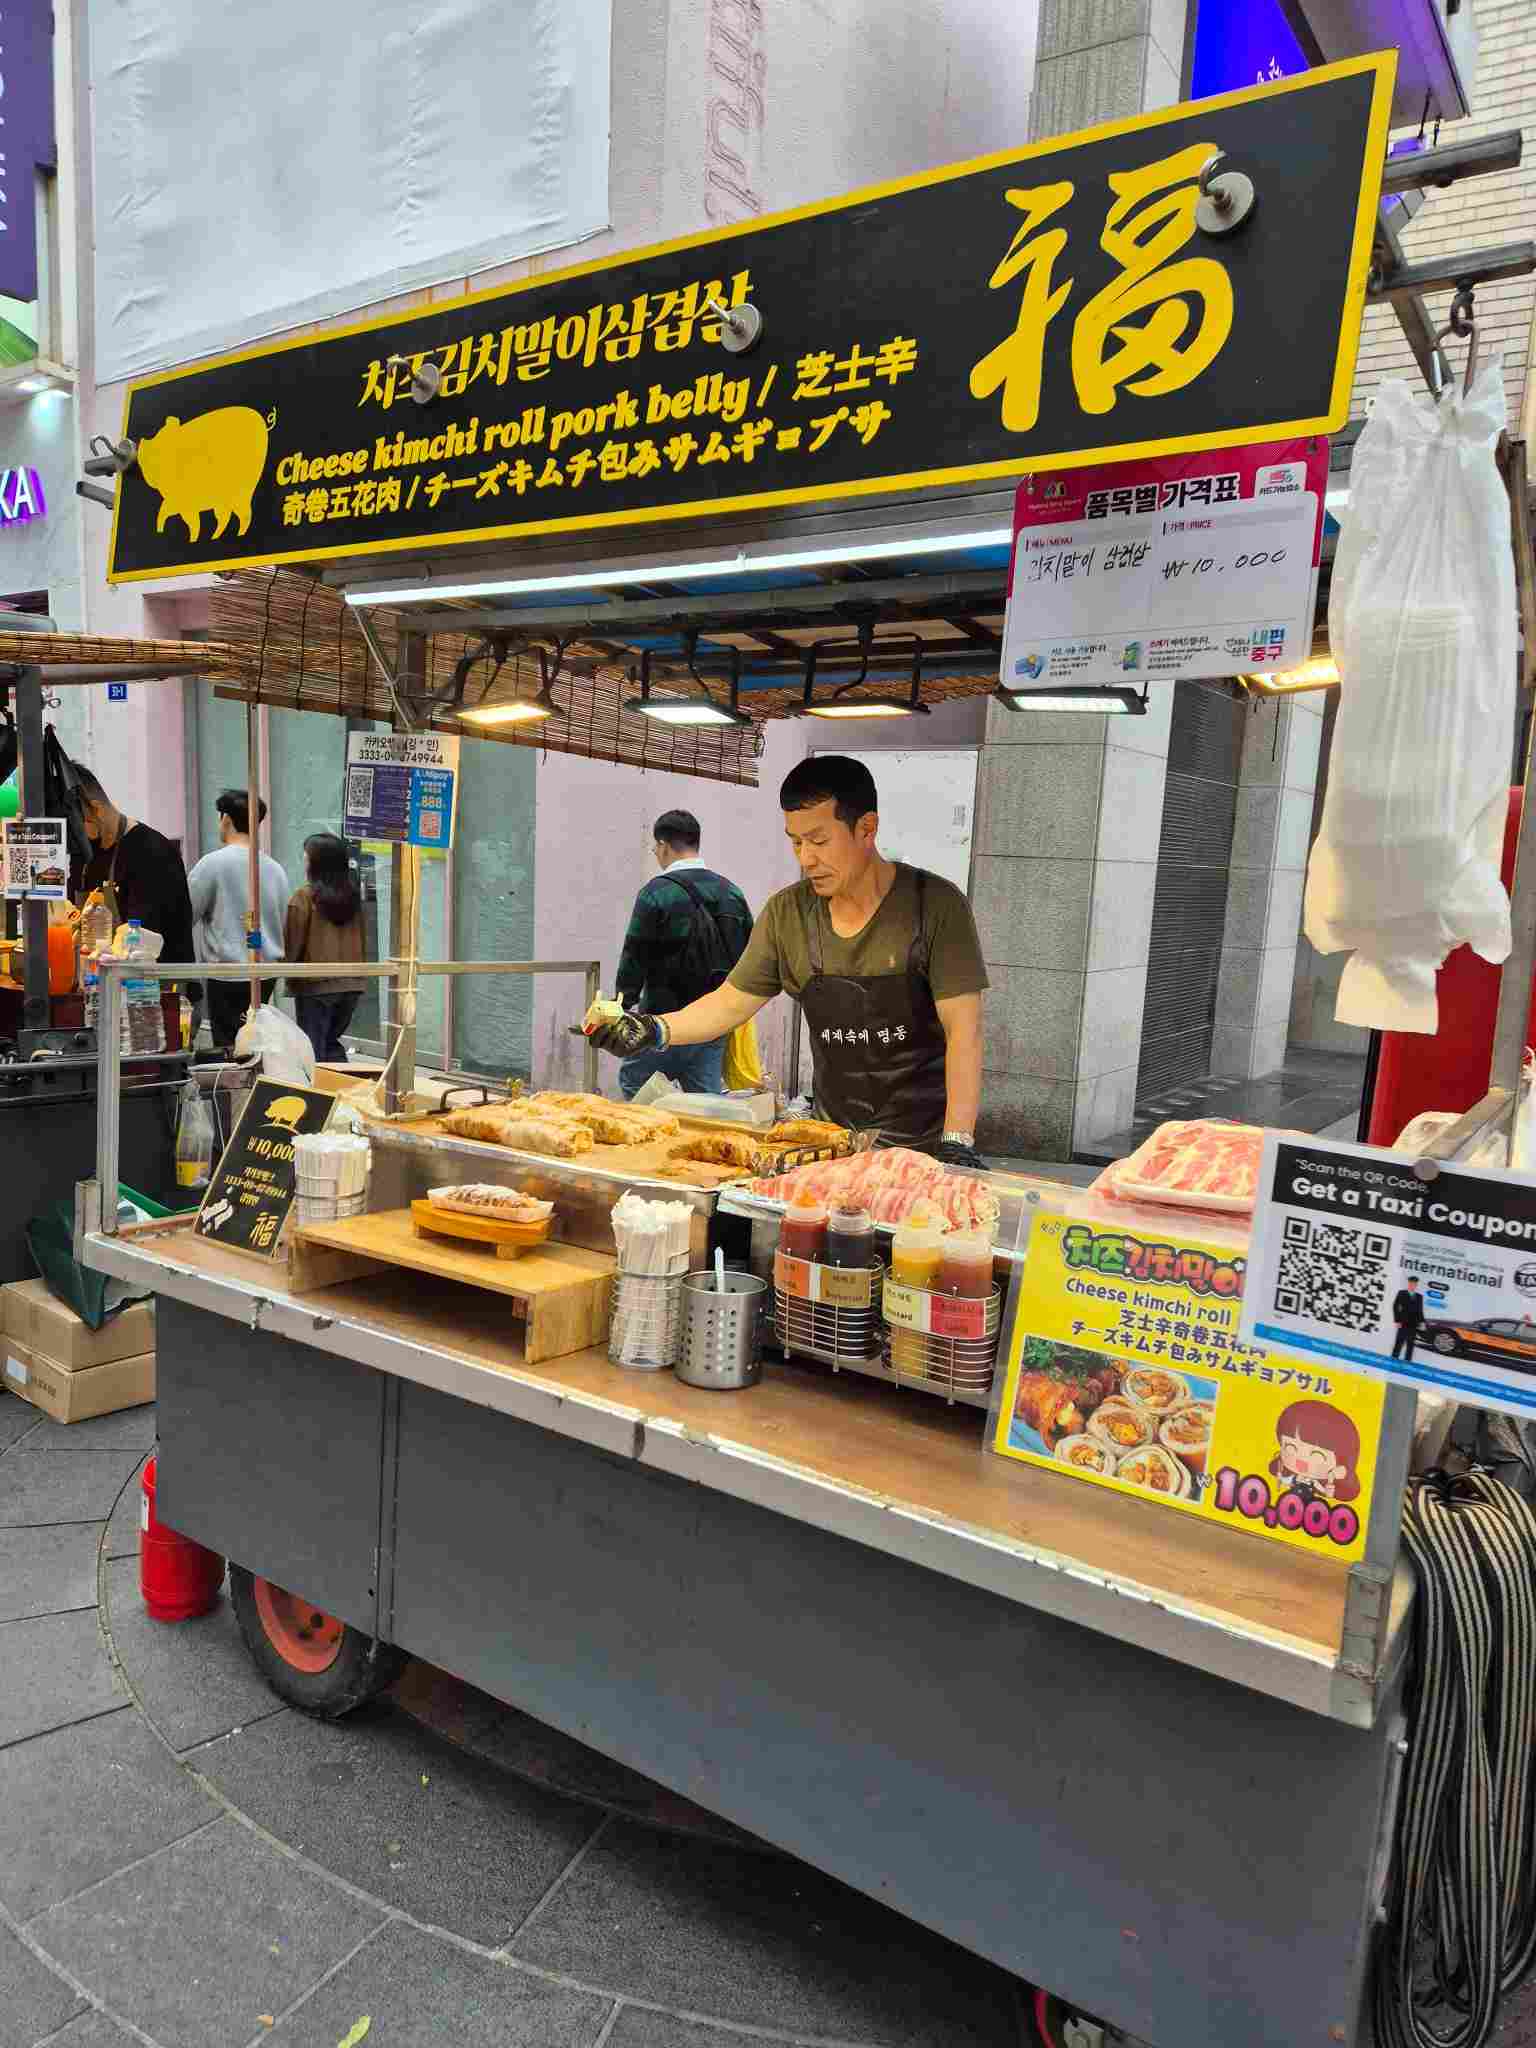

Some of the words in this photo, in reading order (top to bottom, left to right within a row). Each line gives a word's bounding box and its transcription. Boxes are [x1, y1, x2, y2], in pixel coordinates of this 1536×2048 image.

[970, 142, 1234, 433] 福
[357, 269, 753, 410] 치즈김치말이삼겹살
[275, 448, 368, 487] Cheese
[373, 416, 479, 471] kimchi
[483, 405, 546, 450] roll
[549, 390, 640, 451] pork
[646, 371, 751, 423] belly
[792, 335, 918, 402] 芝士辛
[1086, 484, 1159, 520] 품목별
[1162, 473, 1241, 509] 가격표
[876, 1024, 908, 1043] 명동
[1338, 1166, 1361, 1180] the
[1363, 1170, 1385, 1186] QR
[250, 1211, 280, 1248] 福
[1291, 1177, 1337, 1202] Get
[1341, 1188, 1360, 1206] a
[1366, 1190, 1424, 1219] Taxi
[1428, 1202, 1536, 1239] Coupon
[1399, 1255, 1503, 1289] International
[1066, 1277, 1128, 1305] Cheese
[1132, 1286, 1192, 1317] kimchi
[1197, 1300, 1232, 1326] roll
